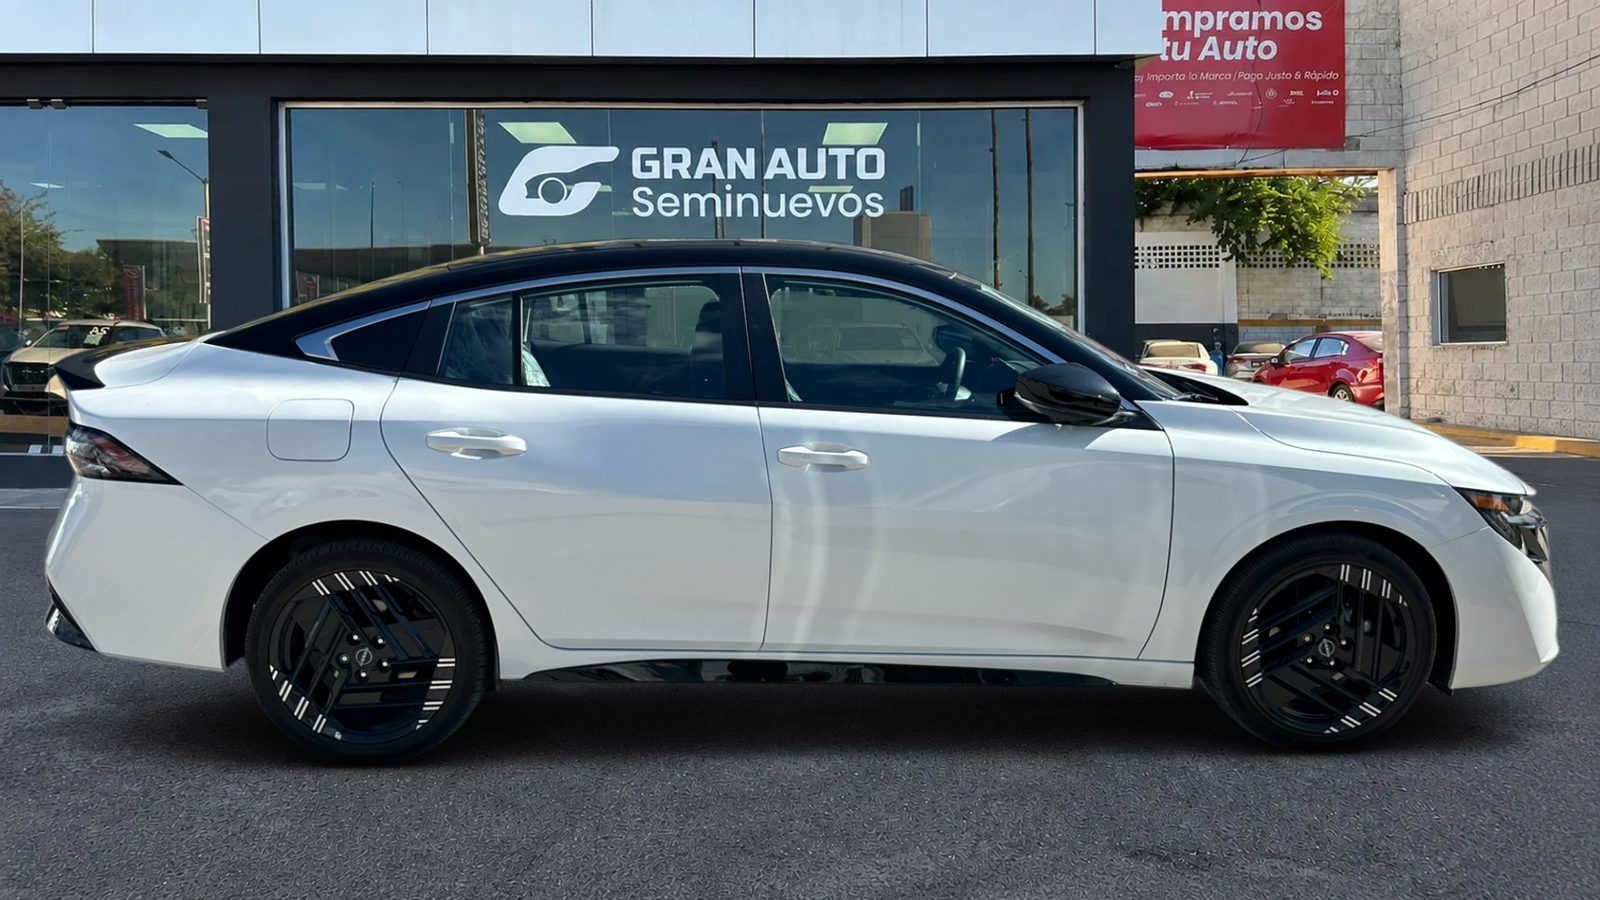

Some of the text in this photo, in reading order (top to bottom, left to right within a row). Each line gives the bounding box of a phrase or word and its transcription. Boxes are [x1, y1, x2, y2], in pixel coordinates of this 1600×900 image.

[1162, 10, 1323, 38] mpramos
[1160, 36, 1278, 61] tu Auto
[1199, 72, 1232, 80] Marca
[1265, 71, 1293, 80] Justo
[1294, 71, 1302, 80] &
[1304, 70, 1340, 82] Rápido
[631, 146, 886, 180] GRAN AUTO
[631, 183, 885, 218] Seminuevos
